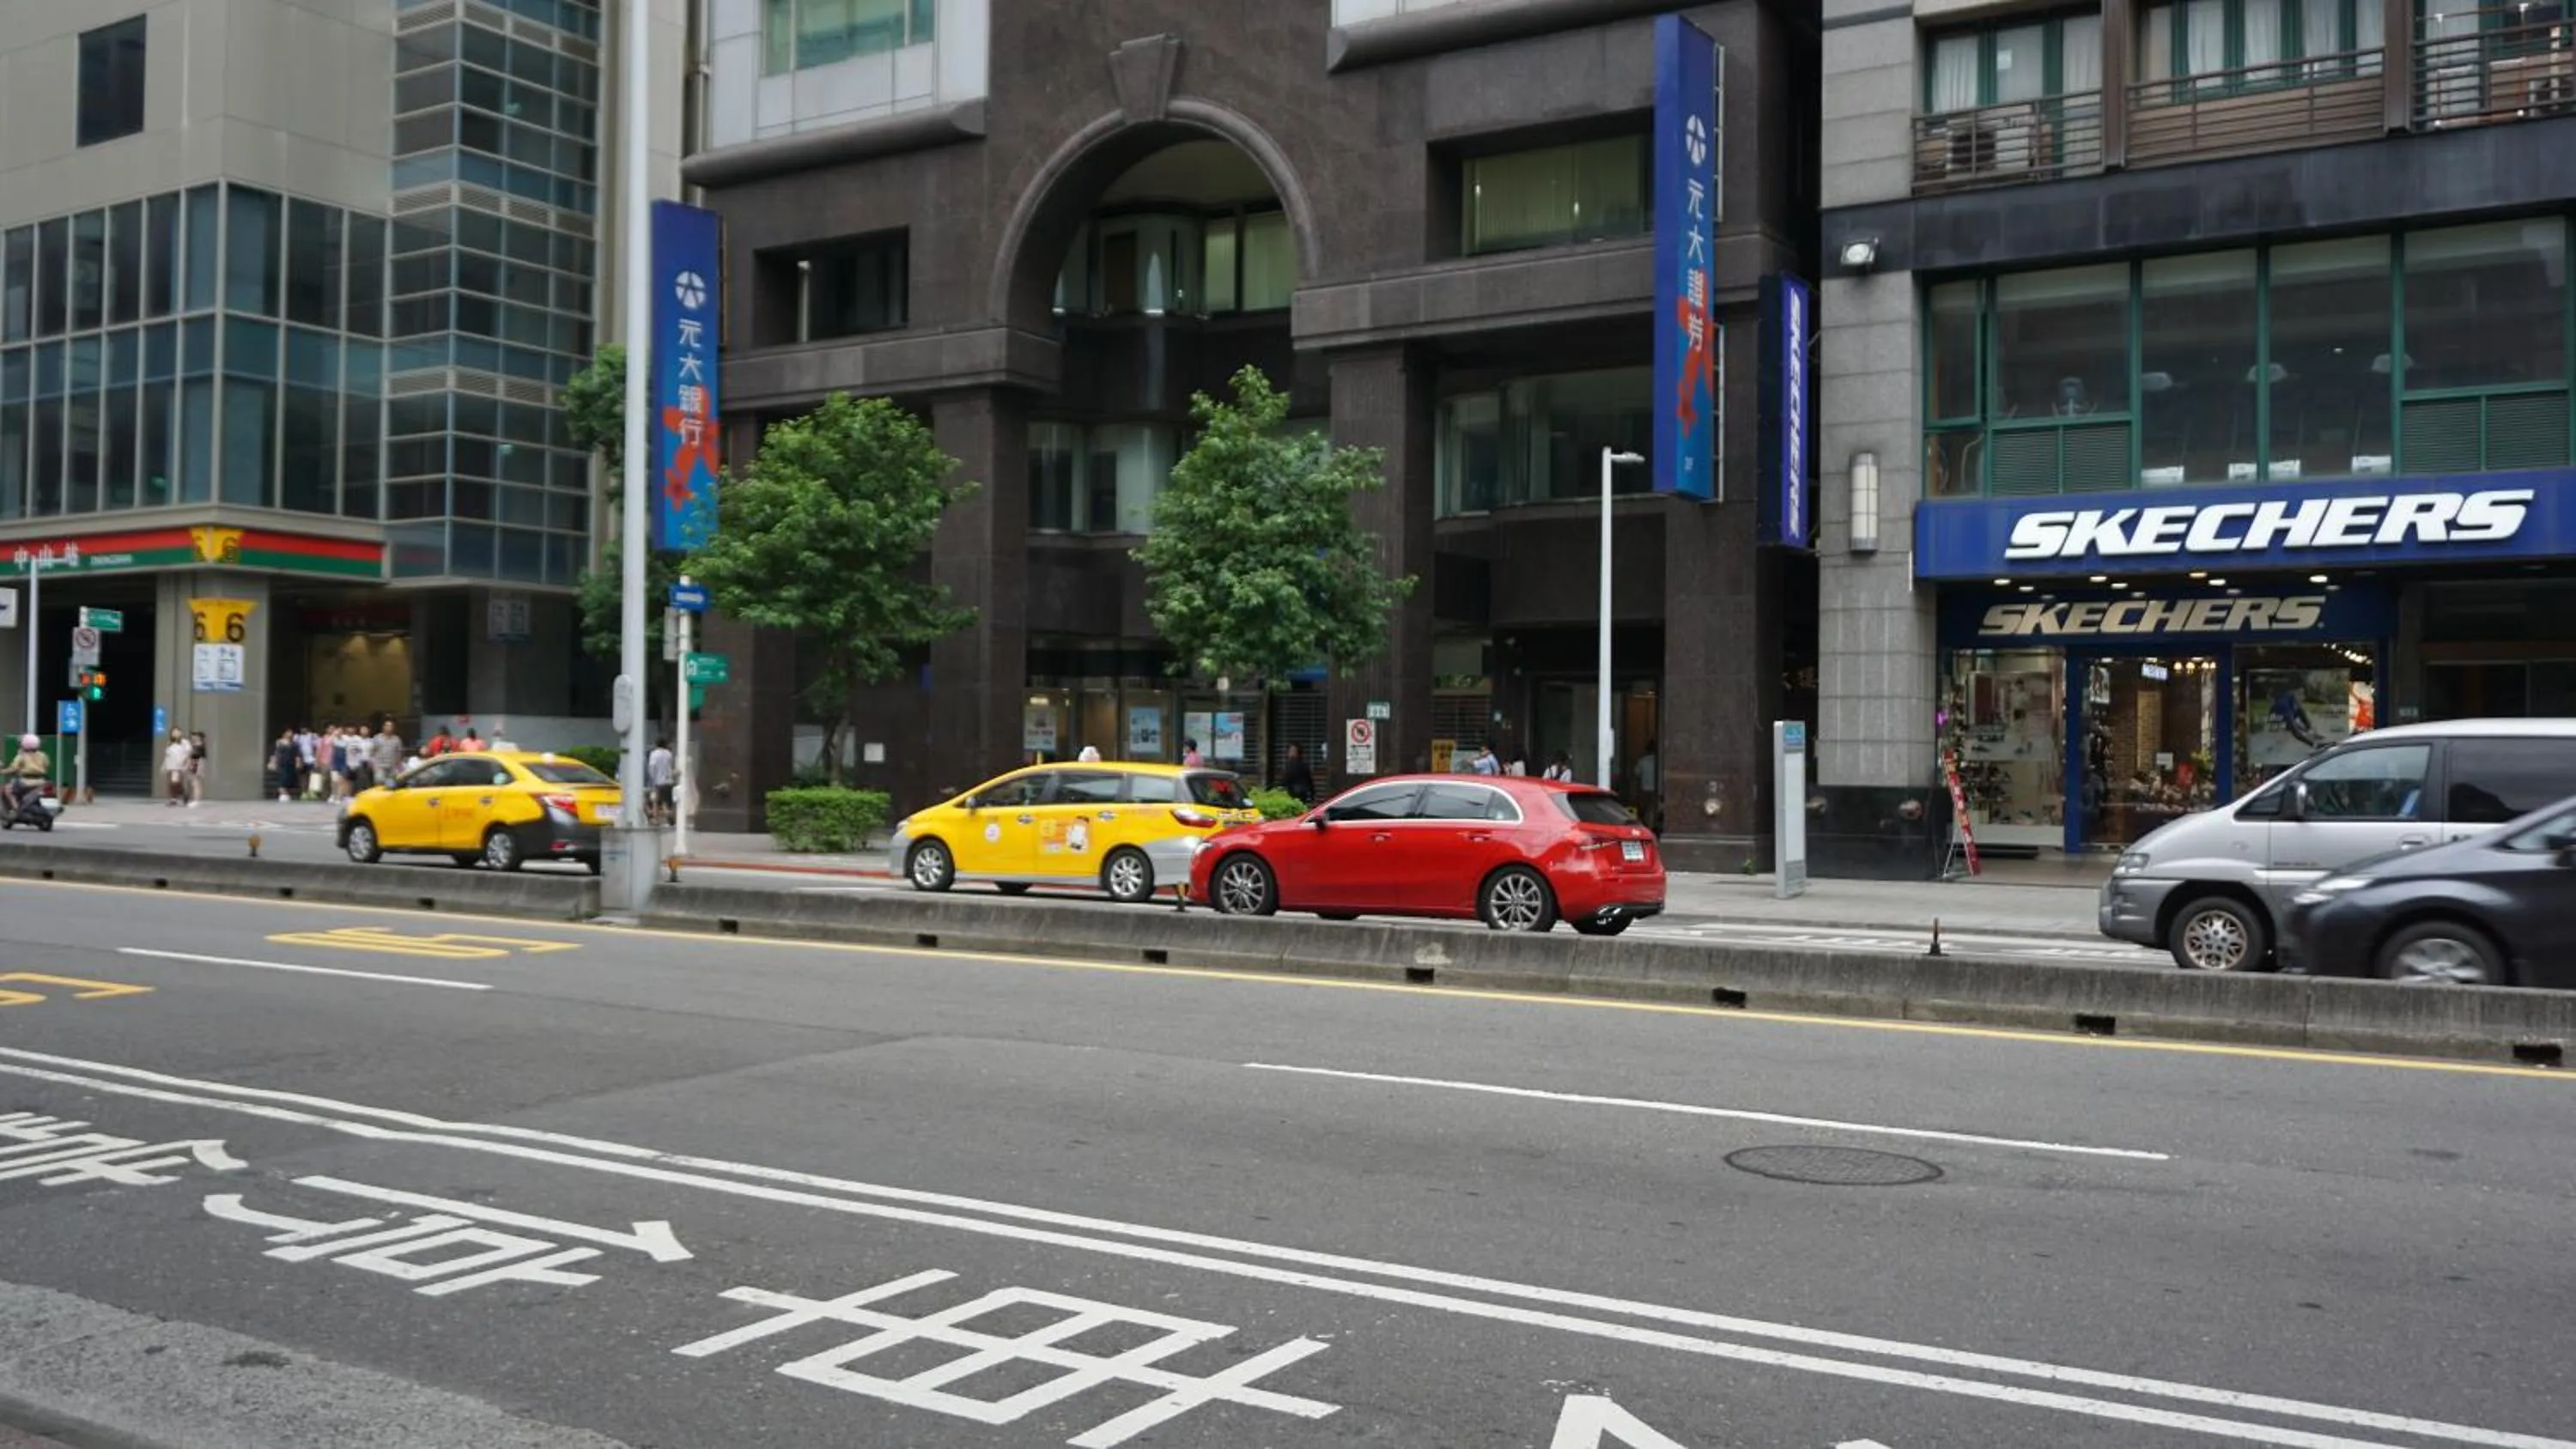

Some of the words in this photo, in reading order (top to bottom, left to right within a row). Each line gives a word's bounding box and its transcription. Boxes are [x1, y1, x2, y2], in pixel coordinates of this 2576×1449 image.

[677, 318, 702, 447] 元大銀行
[2004, 489, 2534, 560] SKECHERS
[222, 536, 238, 565] 6
[193, 611, 206, 640] 6
[225, 611, 245, 642] 6
[1978, 596, 2326, 635] SKECHERS
